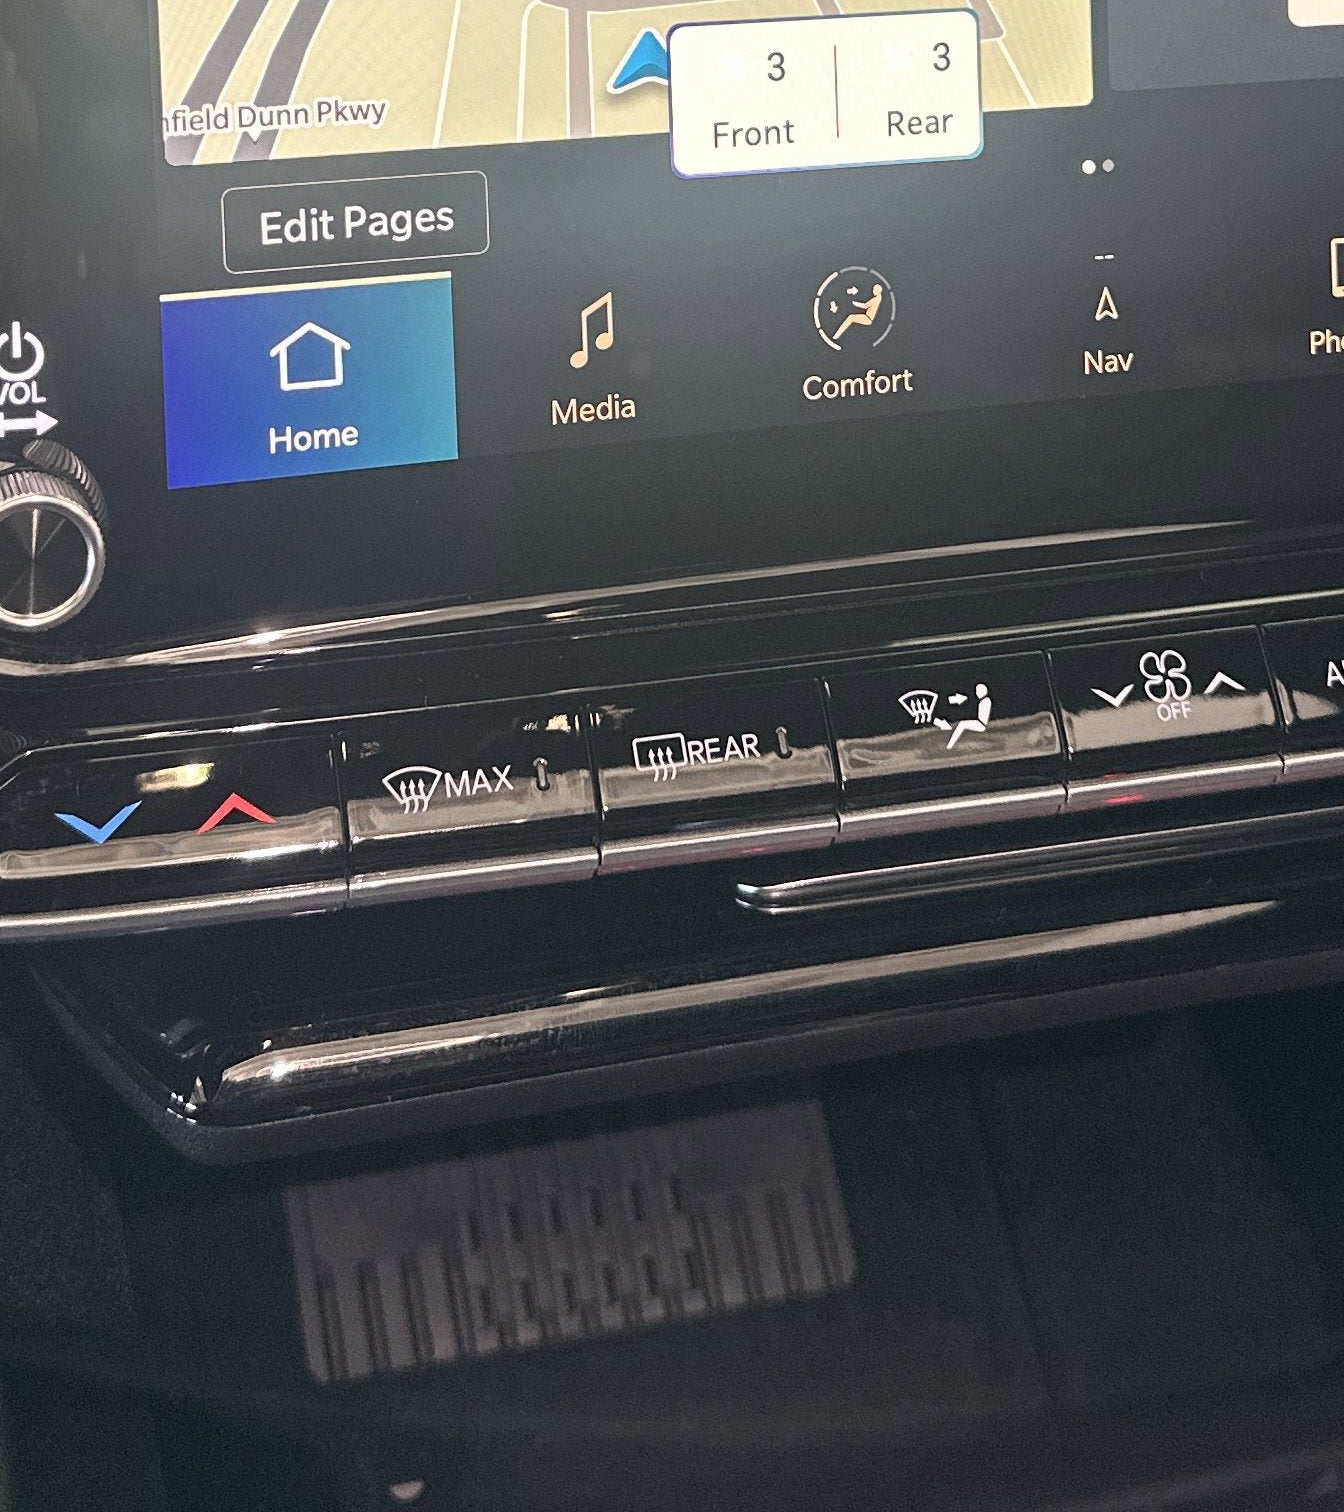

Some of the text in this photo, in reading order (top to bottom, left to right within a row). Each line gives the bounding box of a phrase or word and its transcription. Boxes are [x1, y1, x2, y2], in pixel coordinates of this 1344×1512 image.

[767, 52, 786, 81] 3
[933, 42, 951, 71] 3
[238, 105, 309, 128] Dunn
[317, 100, 387, 125] Pkwy
[887, 110, 953, 136] Rear
[713, 120, 795, 148] Front
[260, 205, 455, 245] Edit Pages
[1084, 349, 1134, 373] Nav
[802, 370, 913, 400] Comfort
[551, 396, 637, 425] Media
[268, 424, 359, 455] Home
[1157, 700, 1193, 721] OFF
[688, 734, 760, 765] REAR
[443, 765, 513, 799] MAX
